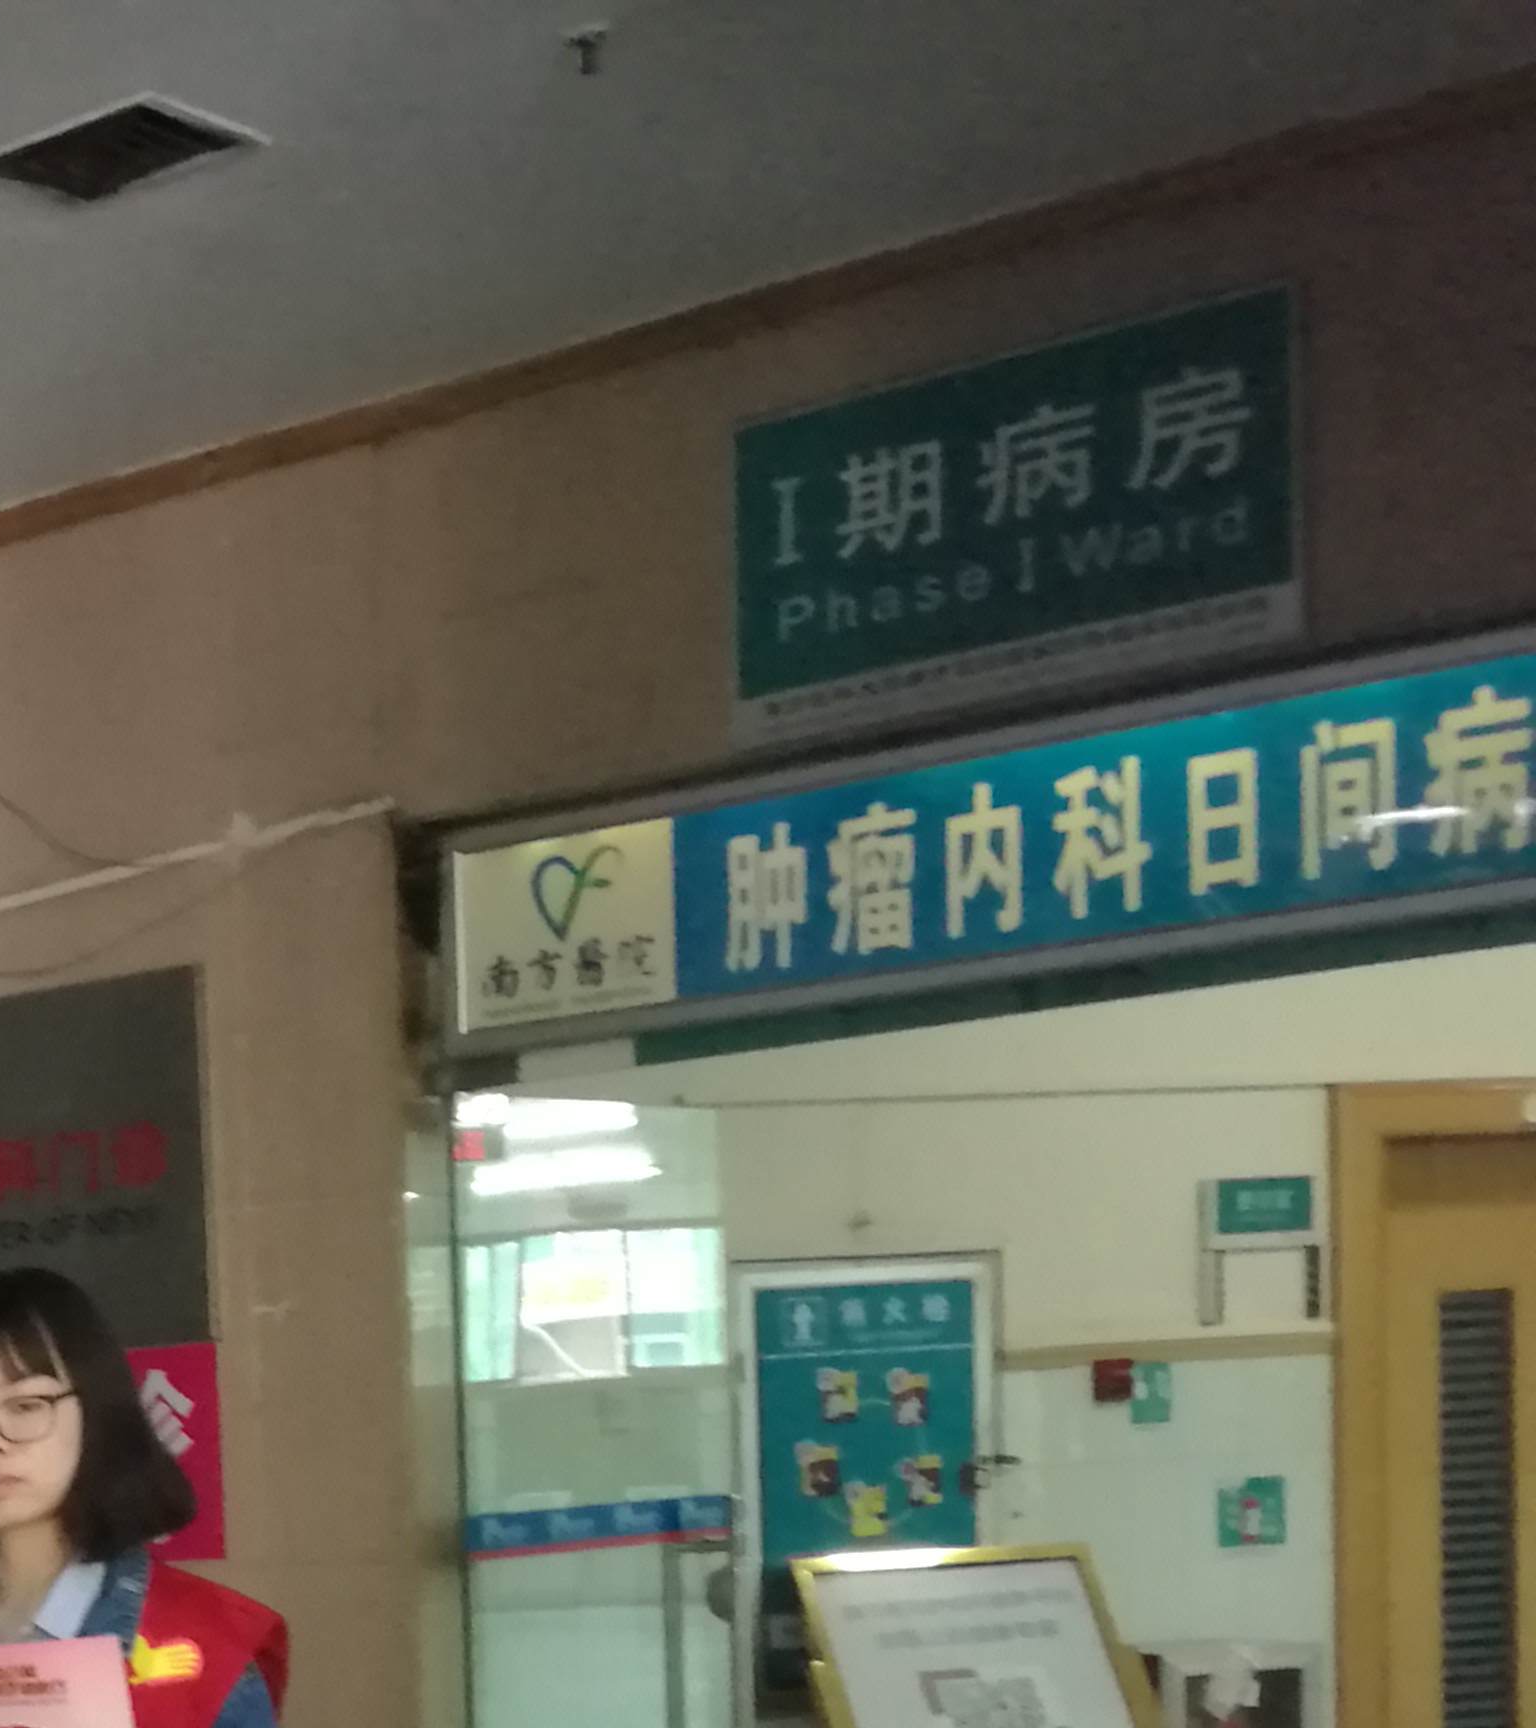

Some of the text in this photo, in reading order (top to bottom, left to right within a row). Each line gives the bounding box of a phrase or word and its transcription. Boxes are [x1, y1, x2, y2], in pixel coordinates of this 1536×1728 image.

[776, 560, 993, 643] Phase
[1058, 499, 1250, 577] Ward
[726, 685, 1533, 974] 肿瘤内科日间病
